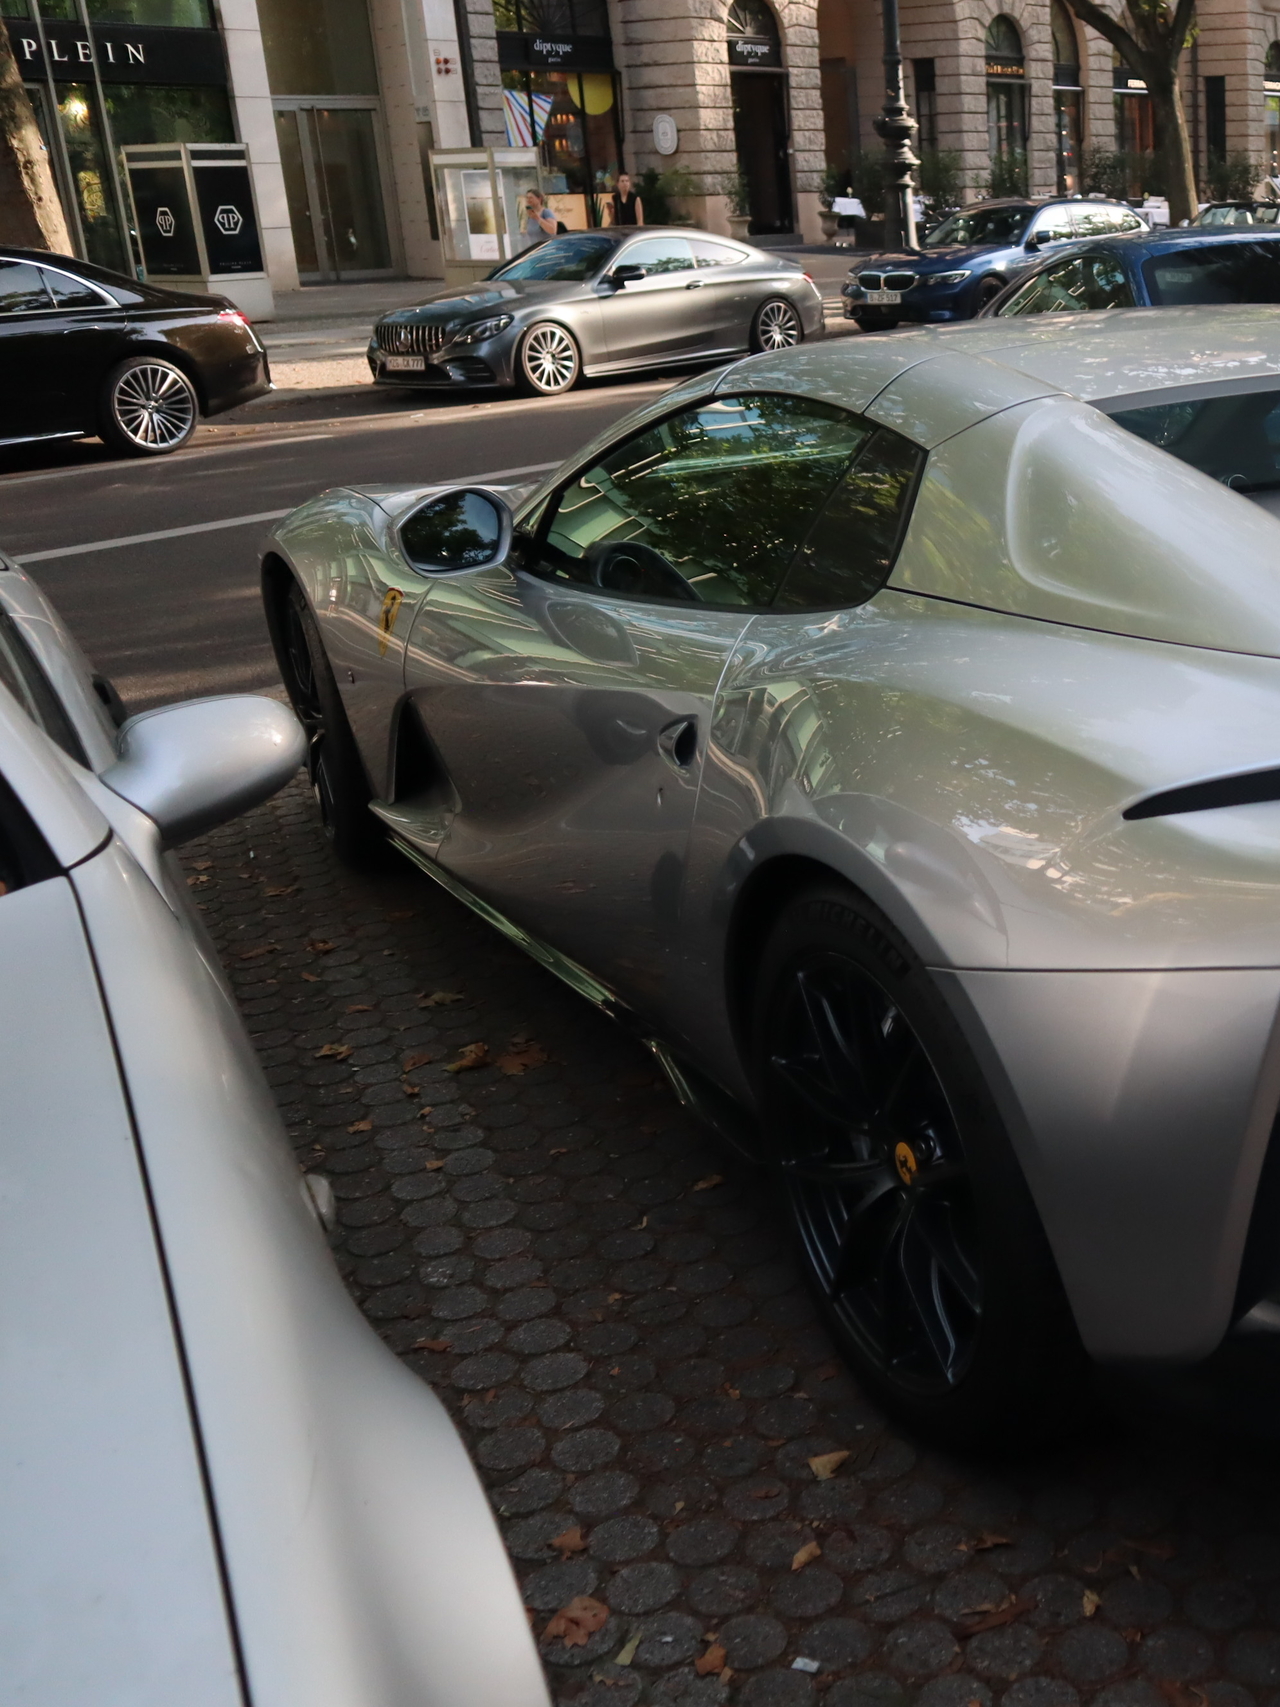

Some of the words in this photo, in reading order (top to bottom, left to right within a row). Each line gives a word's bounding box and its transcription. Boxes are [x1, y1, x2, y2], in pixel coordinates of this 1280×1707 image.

[20, 38, 146, 64] PLEIN
[533, 39, 573, 55] diptyque
[735, 40, 769, 56] diptyque
